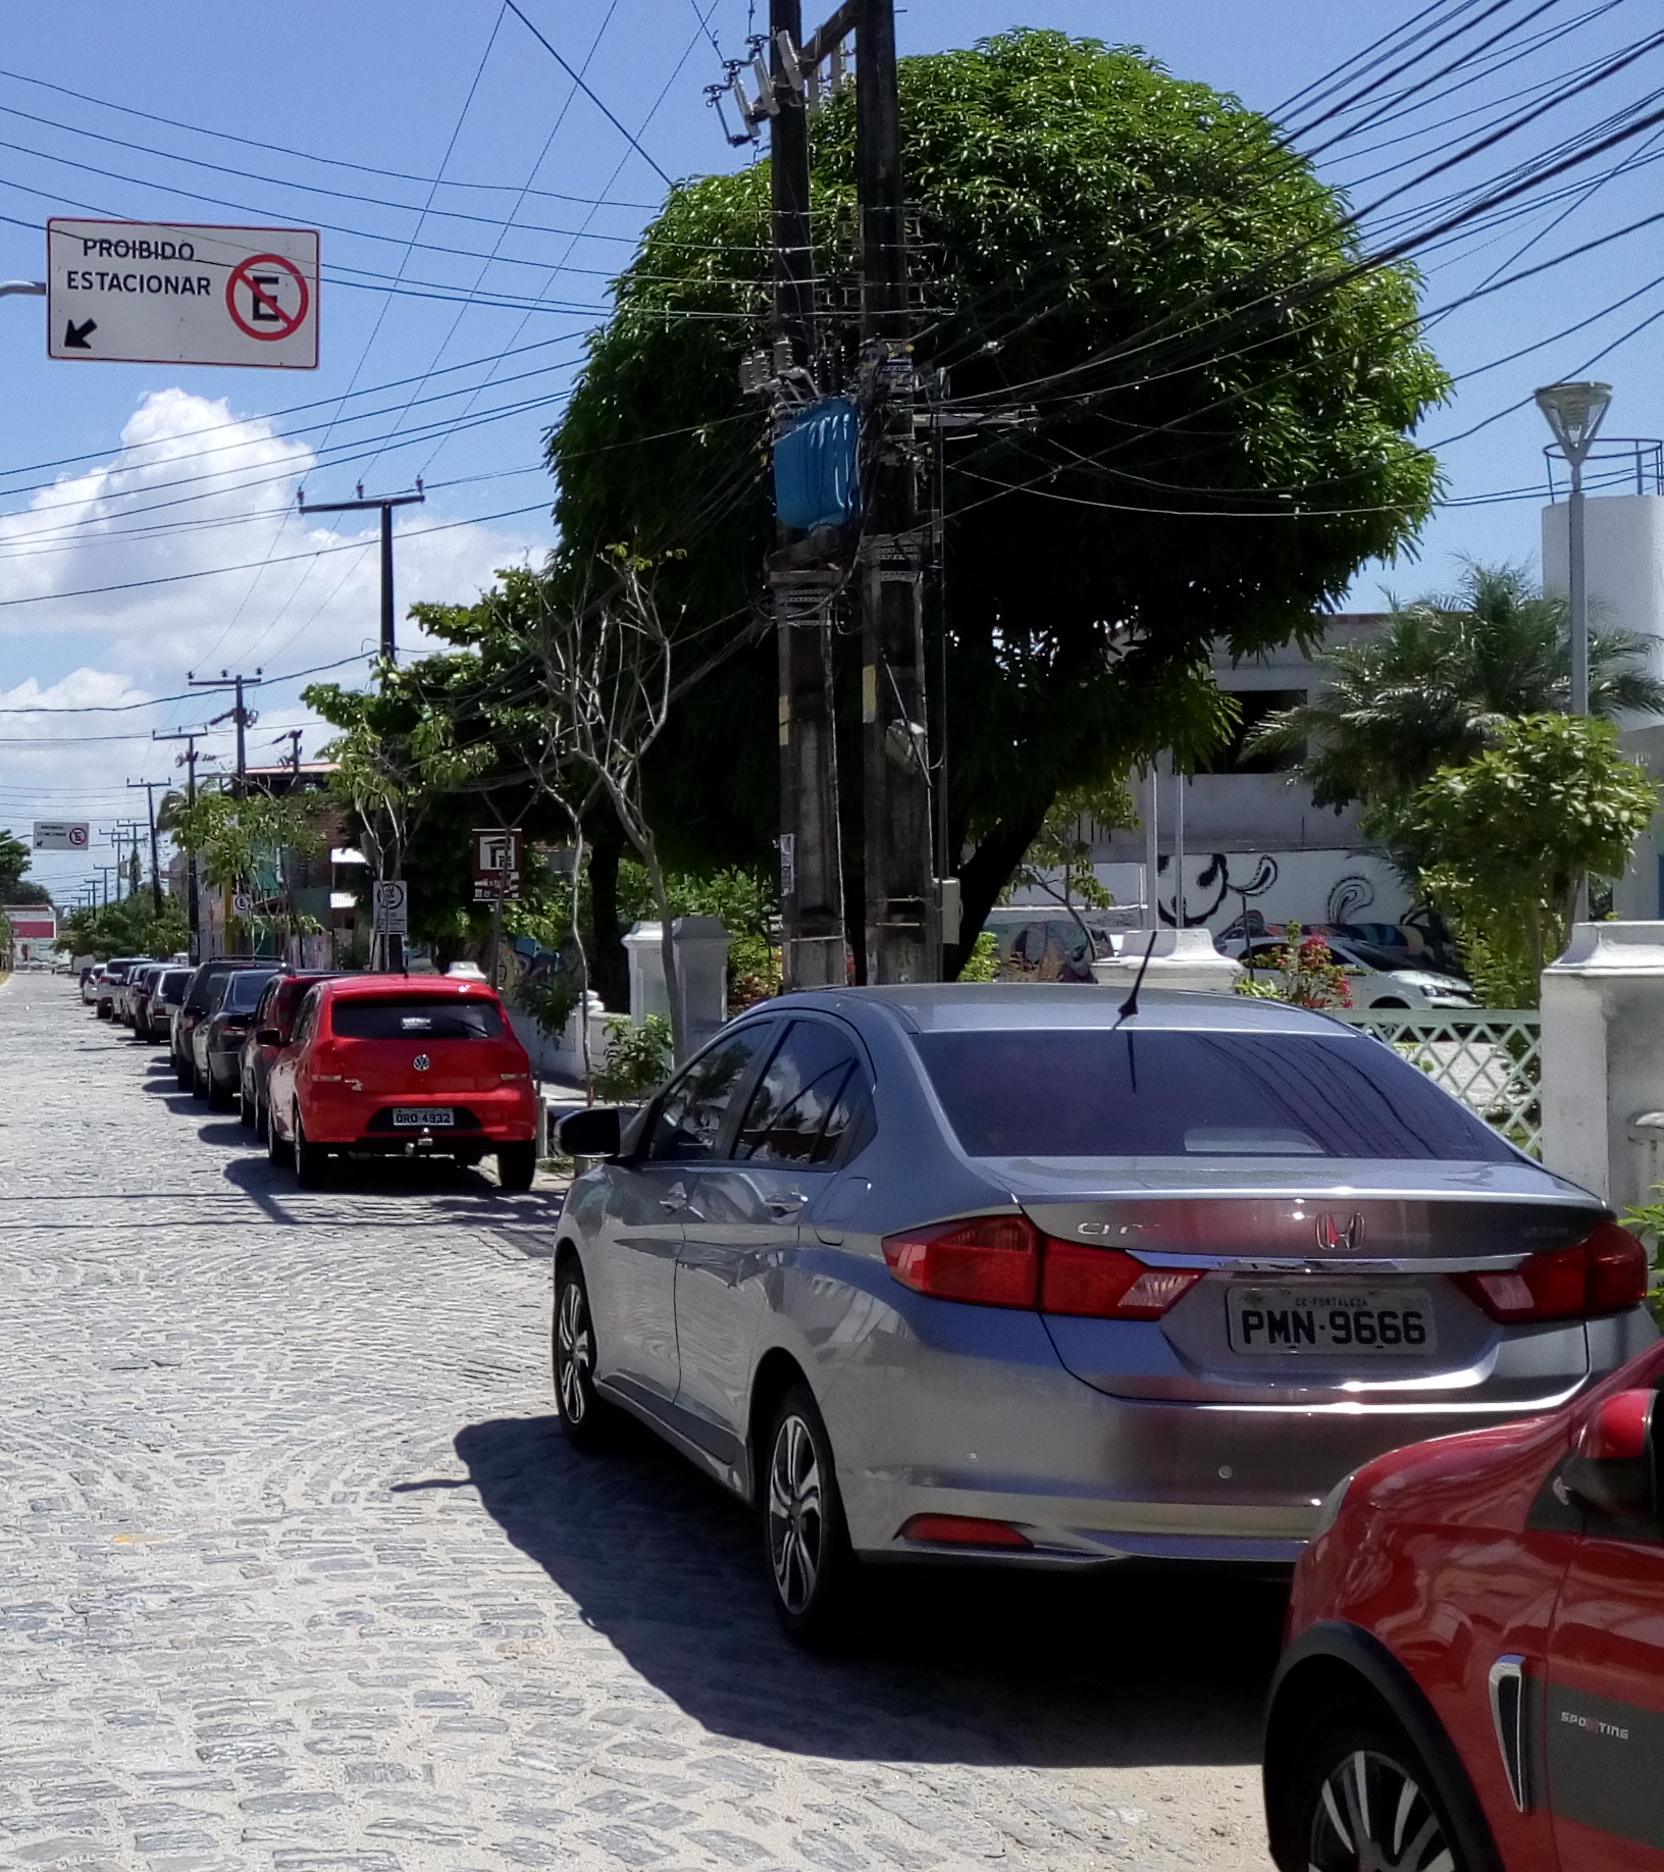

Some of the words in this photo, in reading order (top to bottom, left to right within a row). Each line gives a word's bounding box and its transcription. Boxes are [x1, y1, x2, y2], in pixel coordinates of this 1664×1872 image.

[83, 238, 195, 261] PROIBIDO
[66, 271, 211, 296] ESTACIONAR
[1560, 1711, 1630, 1740] SPORTING
